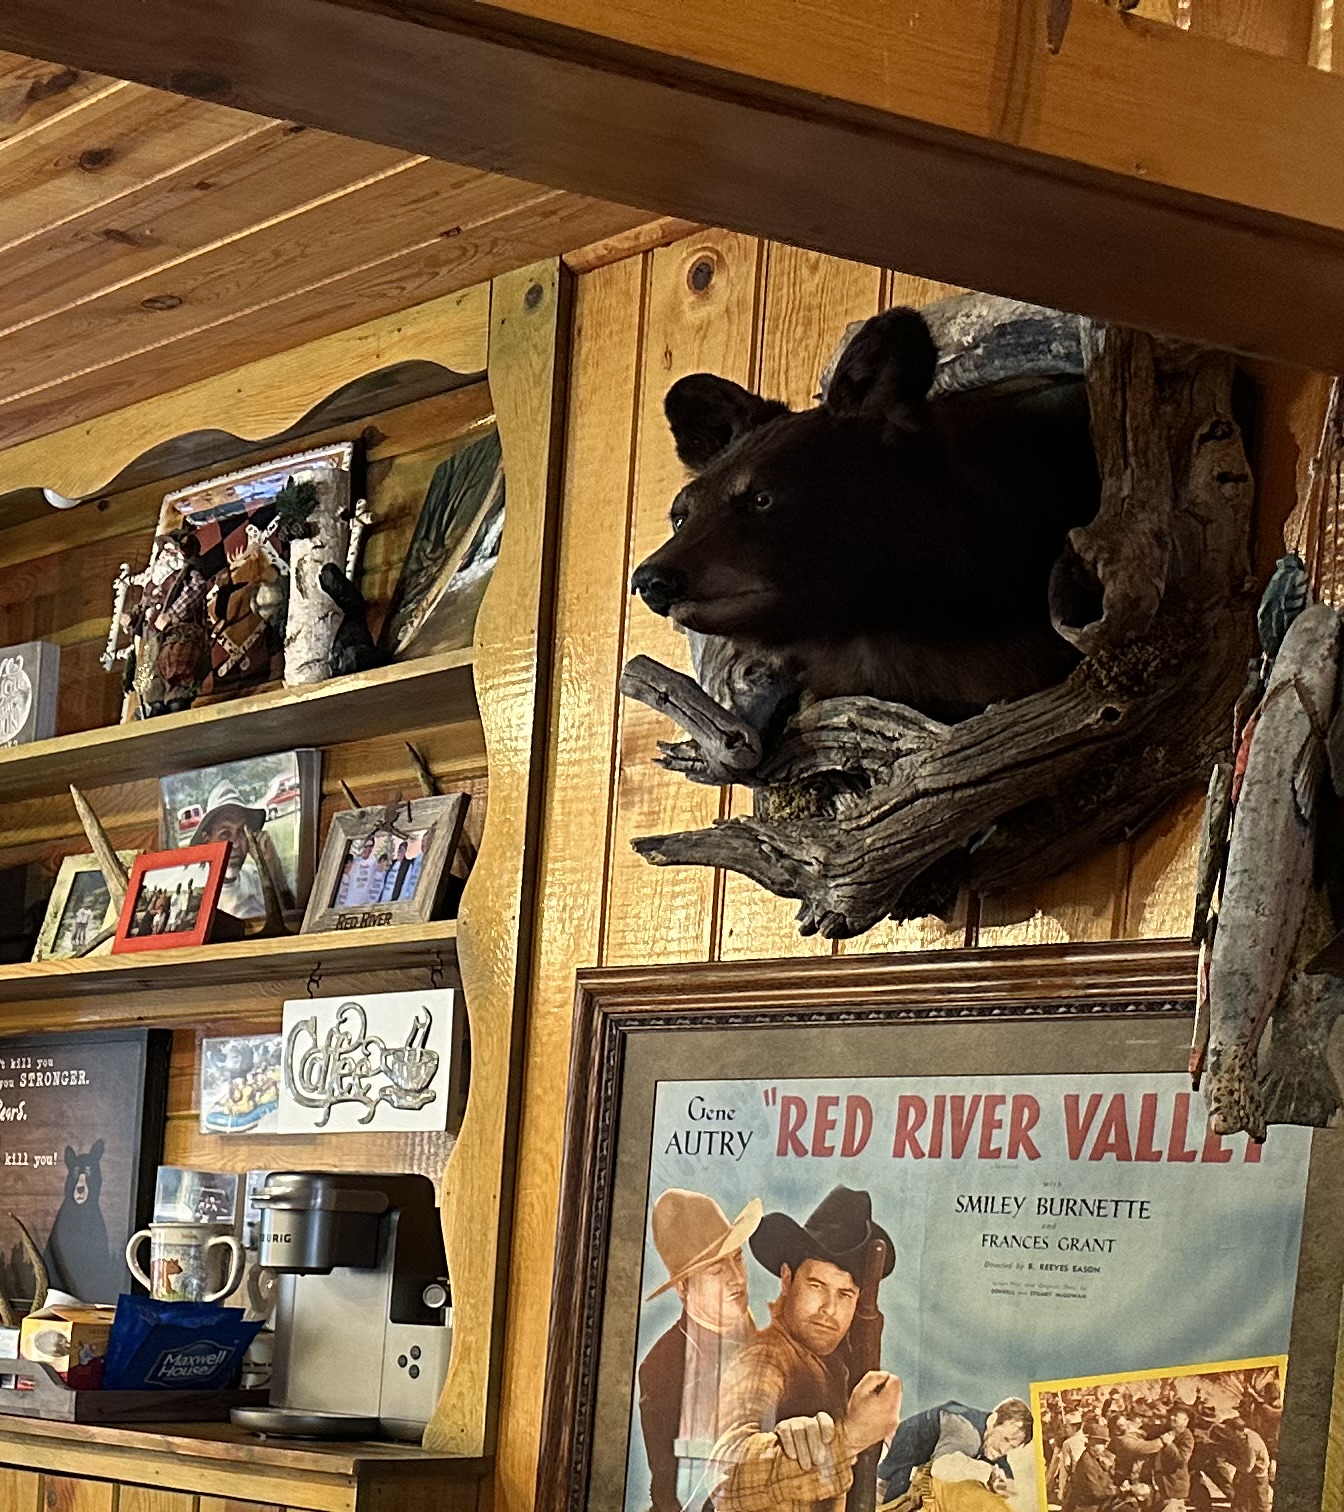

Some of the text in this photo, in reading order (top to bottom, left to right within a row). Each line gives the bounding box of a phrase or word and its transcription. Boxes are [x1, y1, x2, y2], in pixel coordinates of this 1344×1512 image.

[10, 1057, 32, 1069] kill
[36, 1058, 54, 1070] you
[284, 1001, 382, 1127] Coffee
[19, 1070, 90, 1088] STRONGER.
[687, 1095, 737, 1121] Gene
[891, 1094, 1042, 1161] RIVER
[1063, 1092, 1263, 1163] VALL
[664, 1130, 754, 1161] AUTRY
[4, 1152, 29, 1166] kill
[33, 1152, 58, 1169] you!
[955, 1194, 1151, 1220] SMILEY BURNETTE
[981, 1233, 1117, 1253] FRANCES GRANT
[1072, 1265, 1101, 1273] EASON
[163, 1350, 227, 1367] Maxwell
[158, 1363, 212, 1378] House
